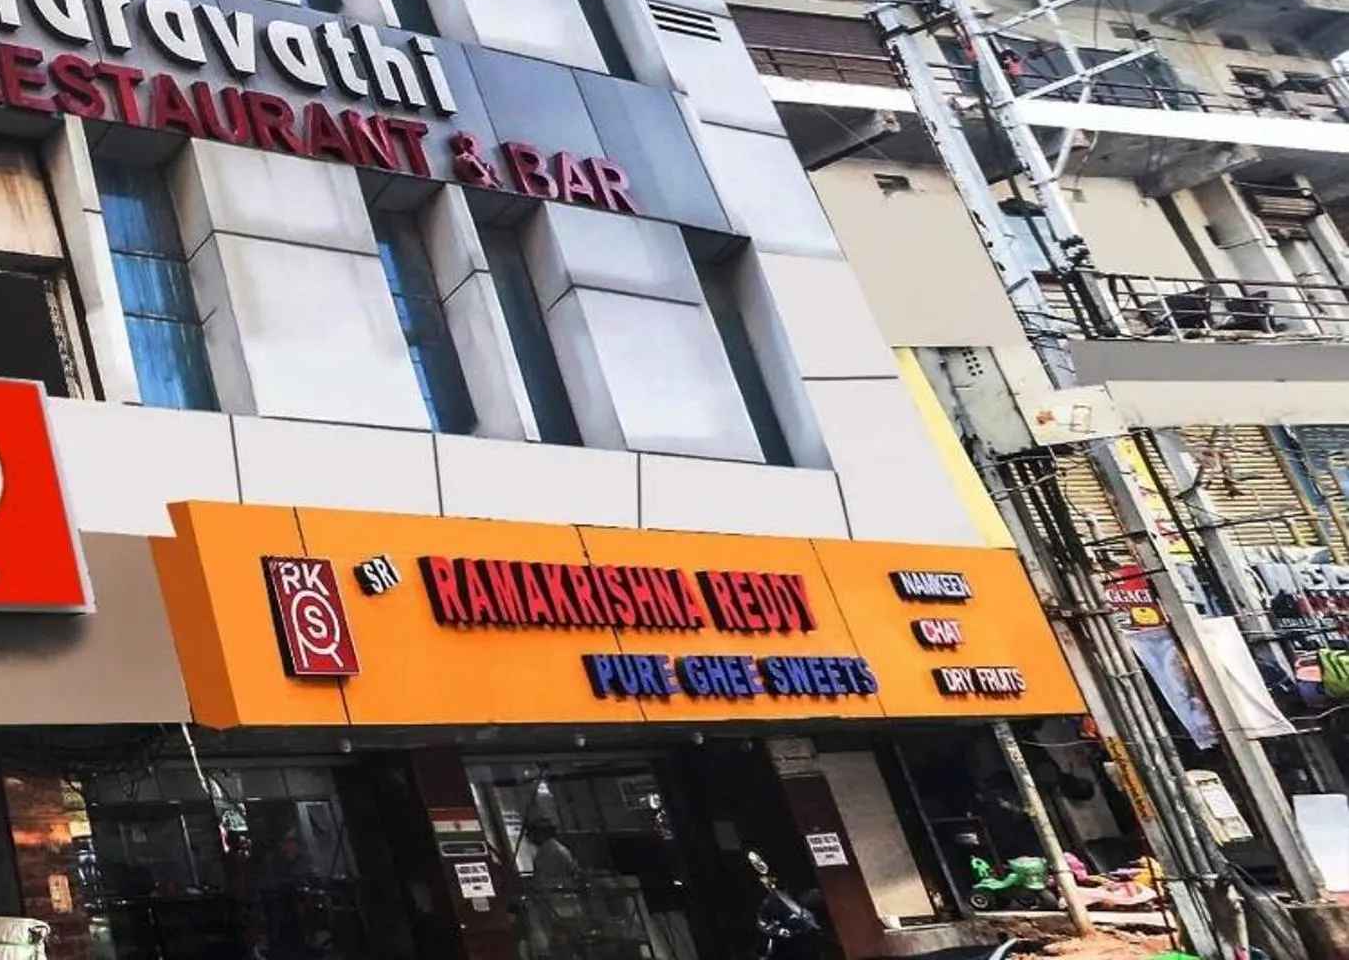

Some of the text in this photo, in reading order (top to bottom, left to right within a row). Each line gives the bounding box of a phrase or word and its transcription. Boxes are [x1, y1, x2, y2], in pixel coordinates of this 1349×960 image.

[450, 130, 503, 189] &
[501, 141, 640, 217] BAR
[358, 554, 402, 594] SRI
[422, 556, 818, 632] RAMAKRISHNA REDDY
[893, 571, 973, 600] NAMKEEN
[914, 618, 963, 647] CHAT
[587, 654, 880, 698] PURE GHEE SWEETS
[938, 667, 1027, 695] DRY FRUITS
